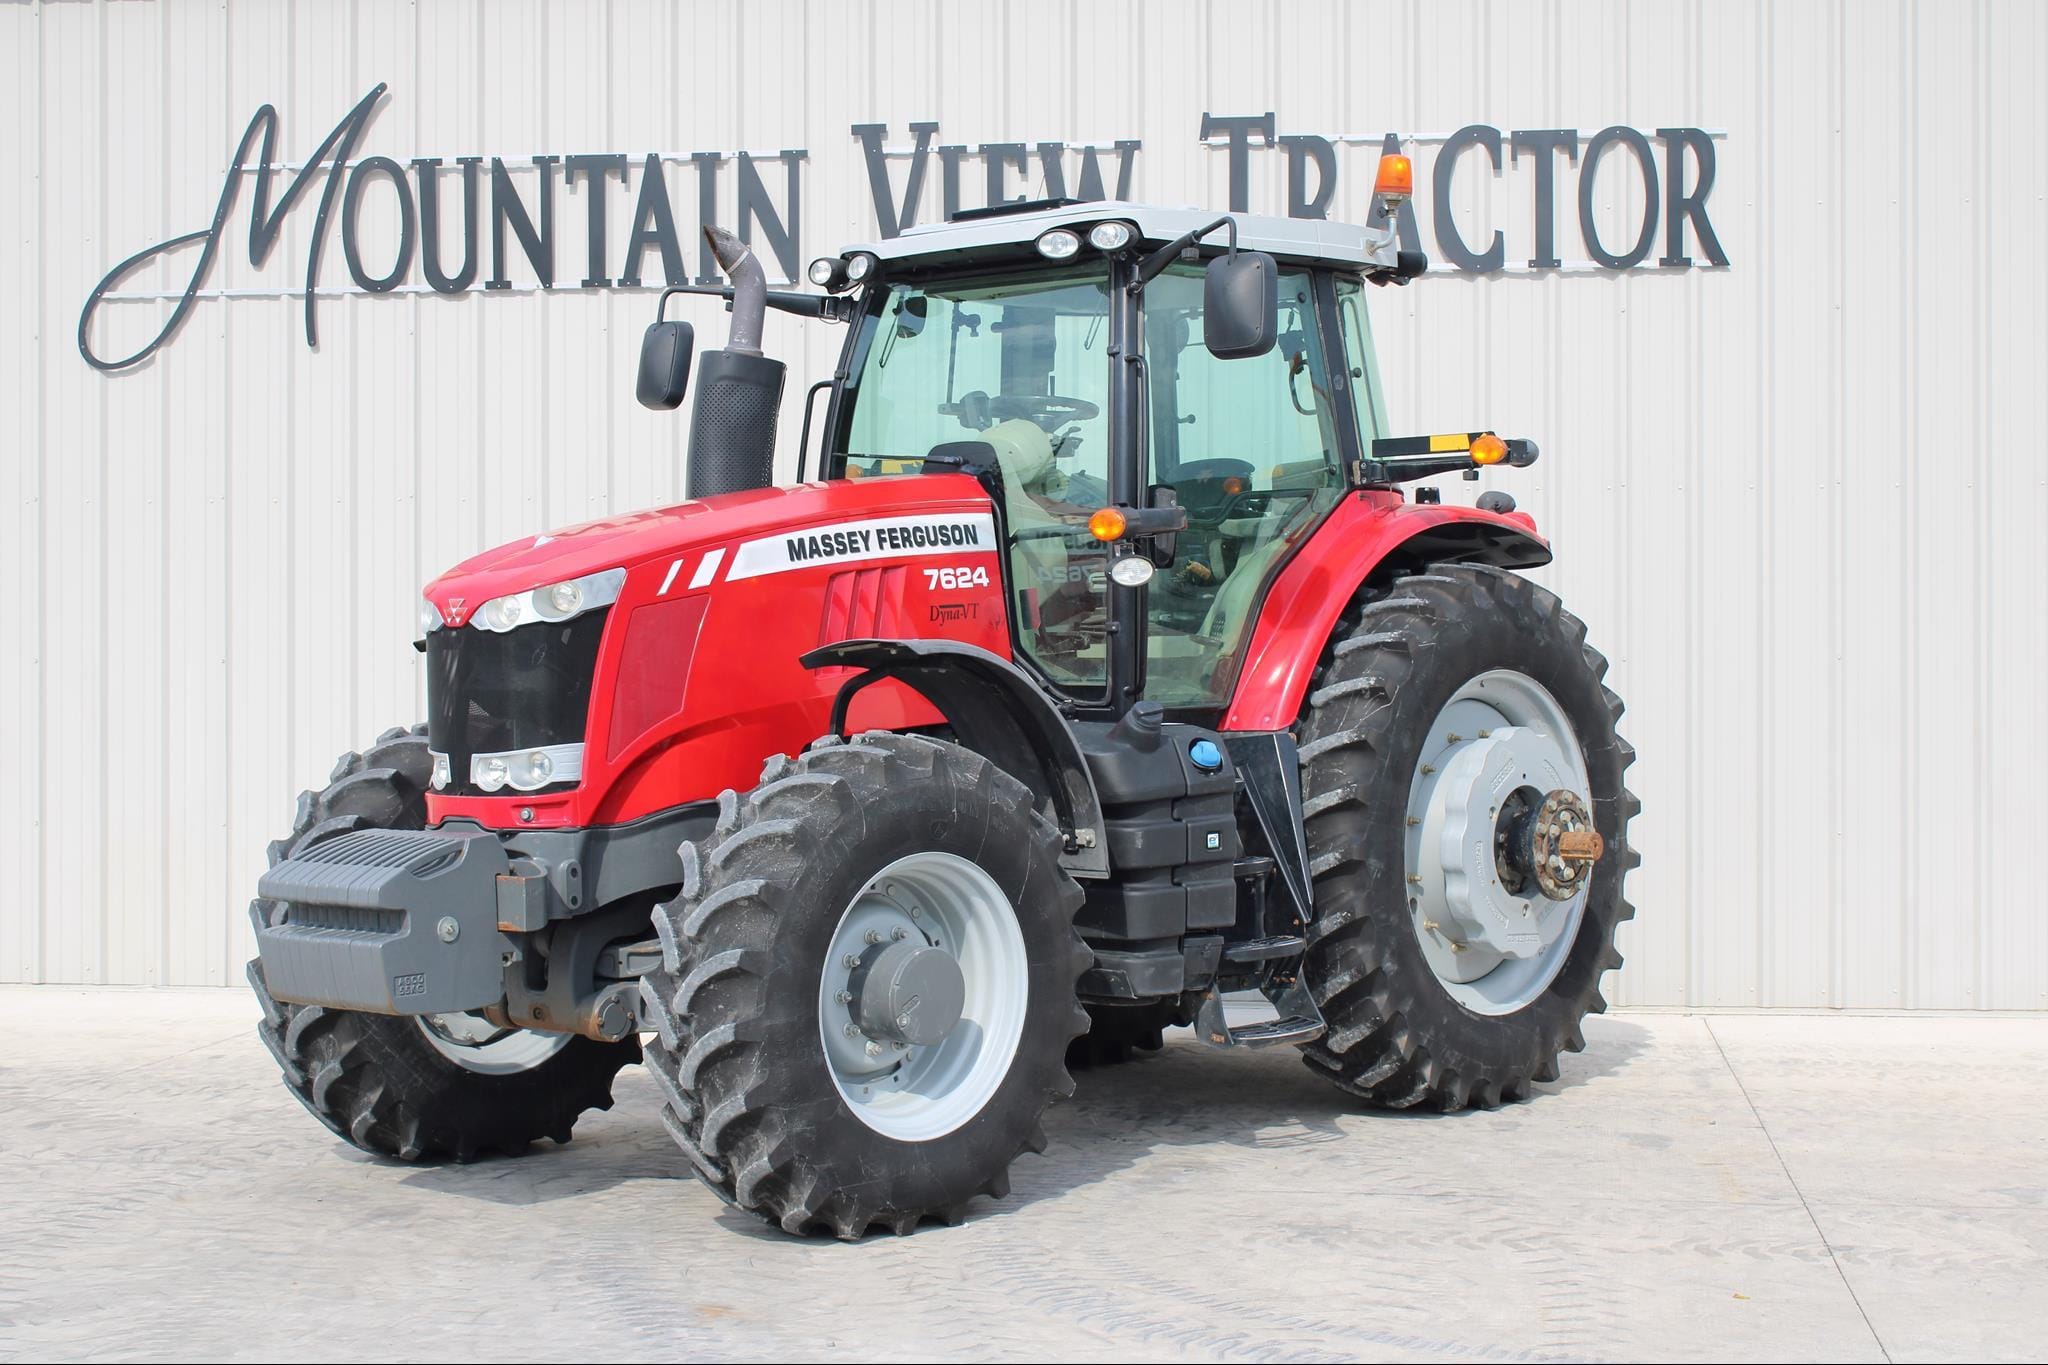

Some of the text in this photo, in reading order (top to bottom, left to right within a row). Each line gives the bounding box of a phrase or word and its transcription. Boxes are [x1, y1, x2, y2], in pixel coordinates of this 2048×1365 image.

[78, 81, 808, 370] MOUNTAIN
[787, 523, 979, 563] MASSEY FERGUSON
[923, 566, 990, 590] 7624
[929, 603, 980, 626] Dyna-VT
